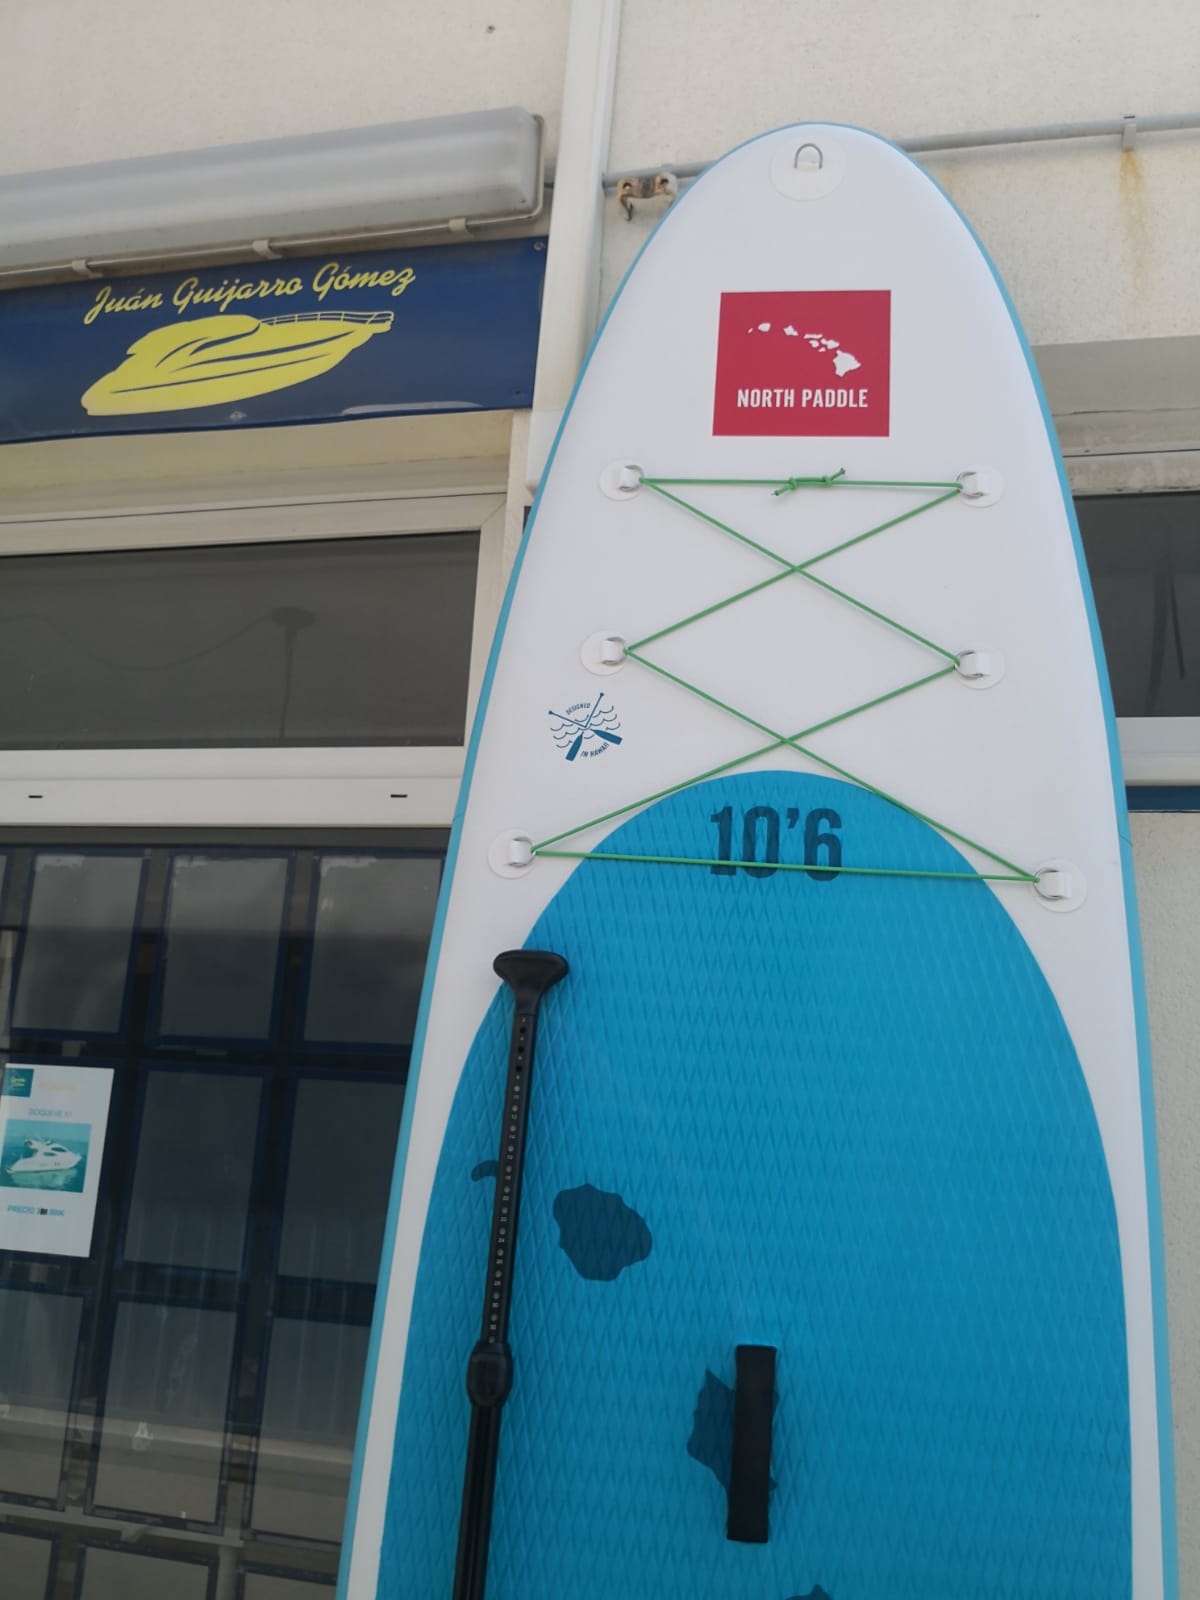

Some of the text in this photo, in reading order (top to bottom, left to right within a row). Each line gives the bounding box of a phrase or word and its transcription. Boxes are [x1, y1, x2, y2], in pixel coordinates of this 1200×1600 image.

[84, 262, 416, 325] Juán Guijarro Gómez
[737, 388, 868, 408] NORTH PADDLE
[565, 702, 591, 715] DESIGNED
[710, 806, 842, 881] 10'6
